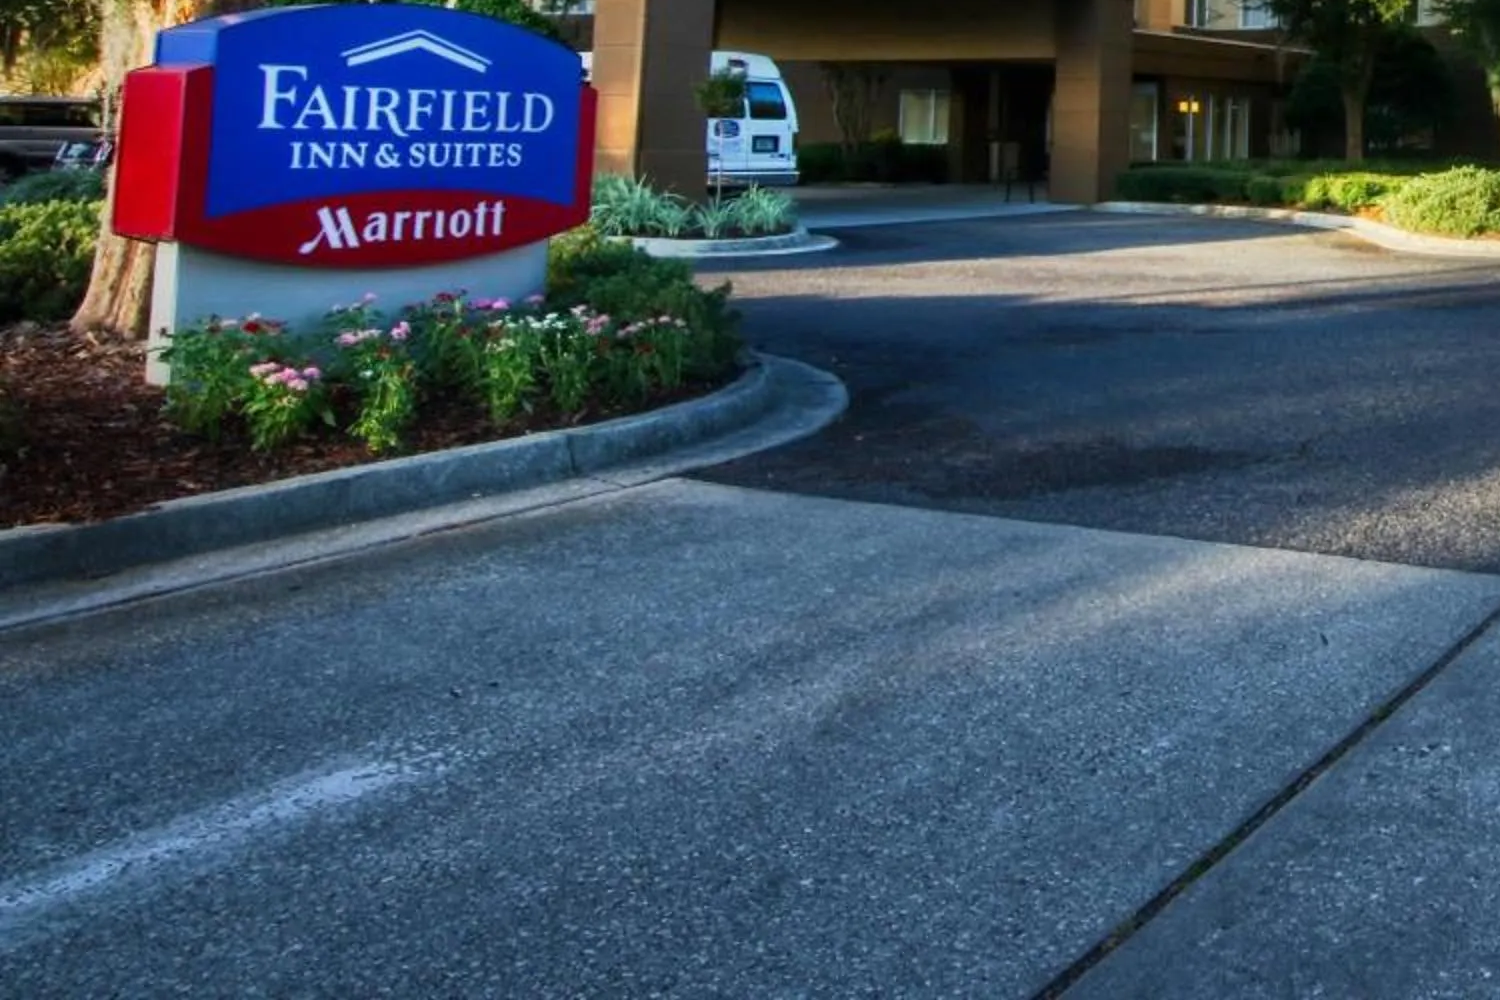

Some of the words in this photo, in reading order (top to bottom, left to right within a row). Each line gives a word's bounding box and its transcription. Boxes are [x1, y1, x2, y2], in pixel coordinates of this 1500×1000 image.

[257, 63, 553, 136] FAIRFIELD
[289, 142, 366, 169] INN
[374, 143, 401, 168] &
[409, 142, 522, 168] SUITES
[298, 200, 506, 255] Marriott
